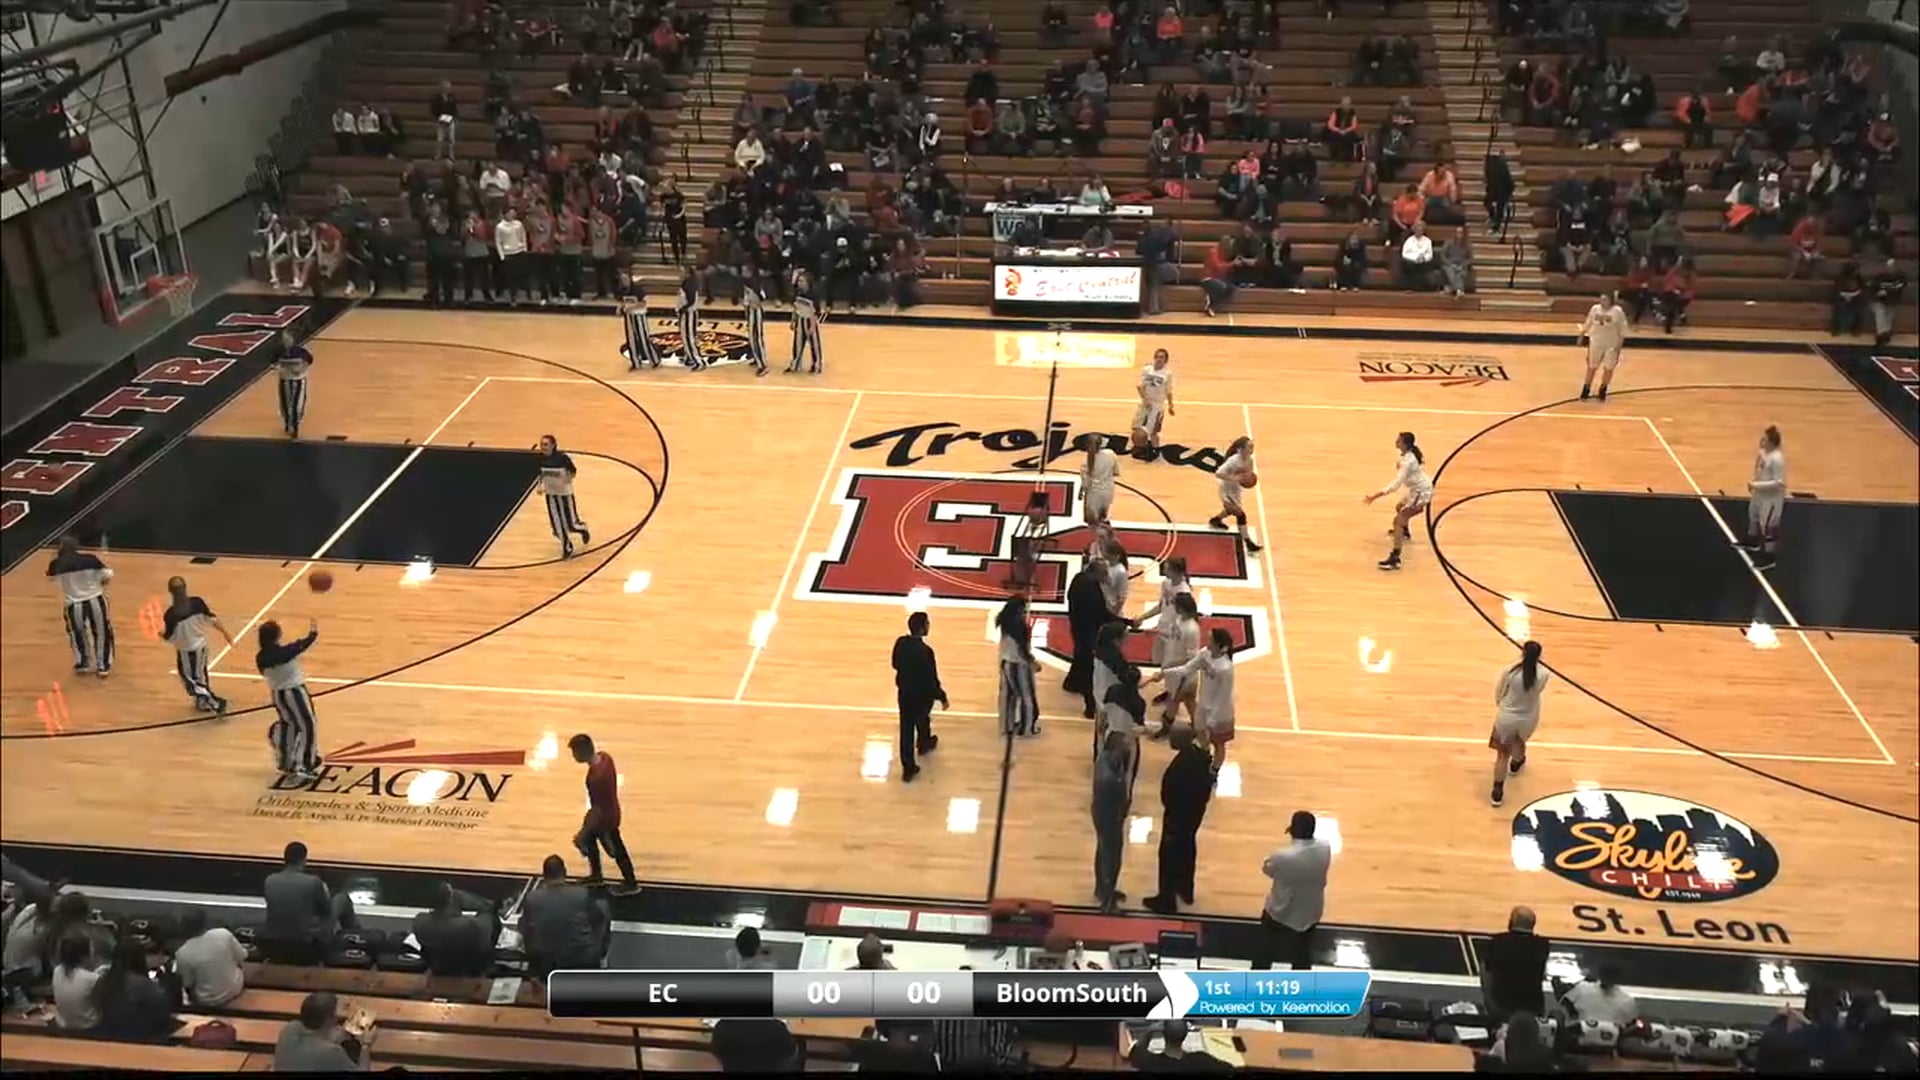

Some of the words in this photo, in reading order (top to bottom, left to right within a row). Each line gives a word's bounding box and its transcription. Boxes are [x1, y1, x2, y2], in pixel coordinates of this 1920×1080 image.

[1360, 361, 1510, 381] BEACON
[850, 421, 1226, 474] Trojans
[354, 801, 368, 811] &
[376, 803, 417, 815] Sports
[423, 805, 490, 819] Medicine
[1555, 822, 1756, 899] Skylie
[1572, 903, 1646, 936] St.
[1657, 908, 1791, 945] Leon
